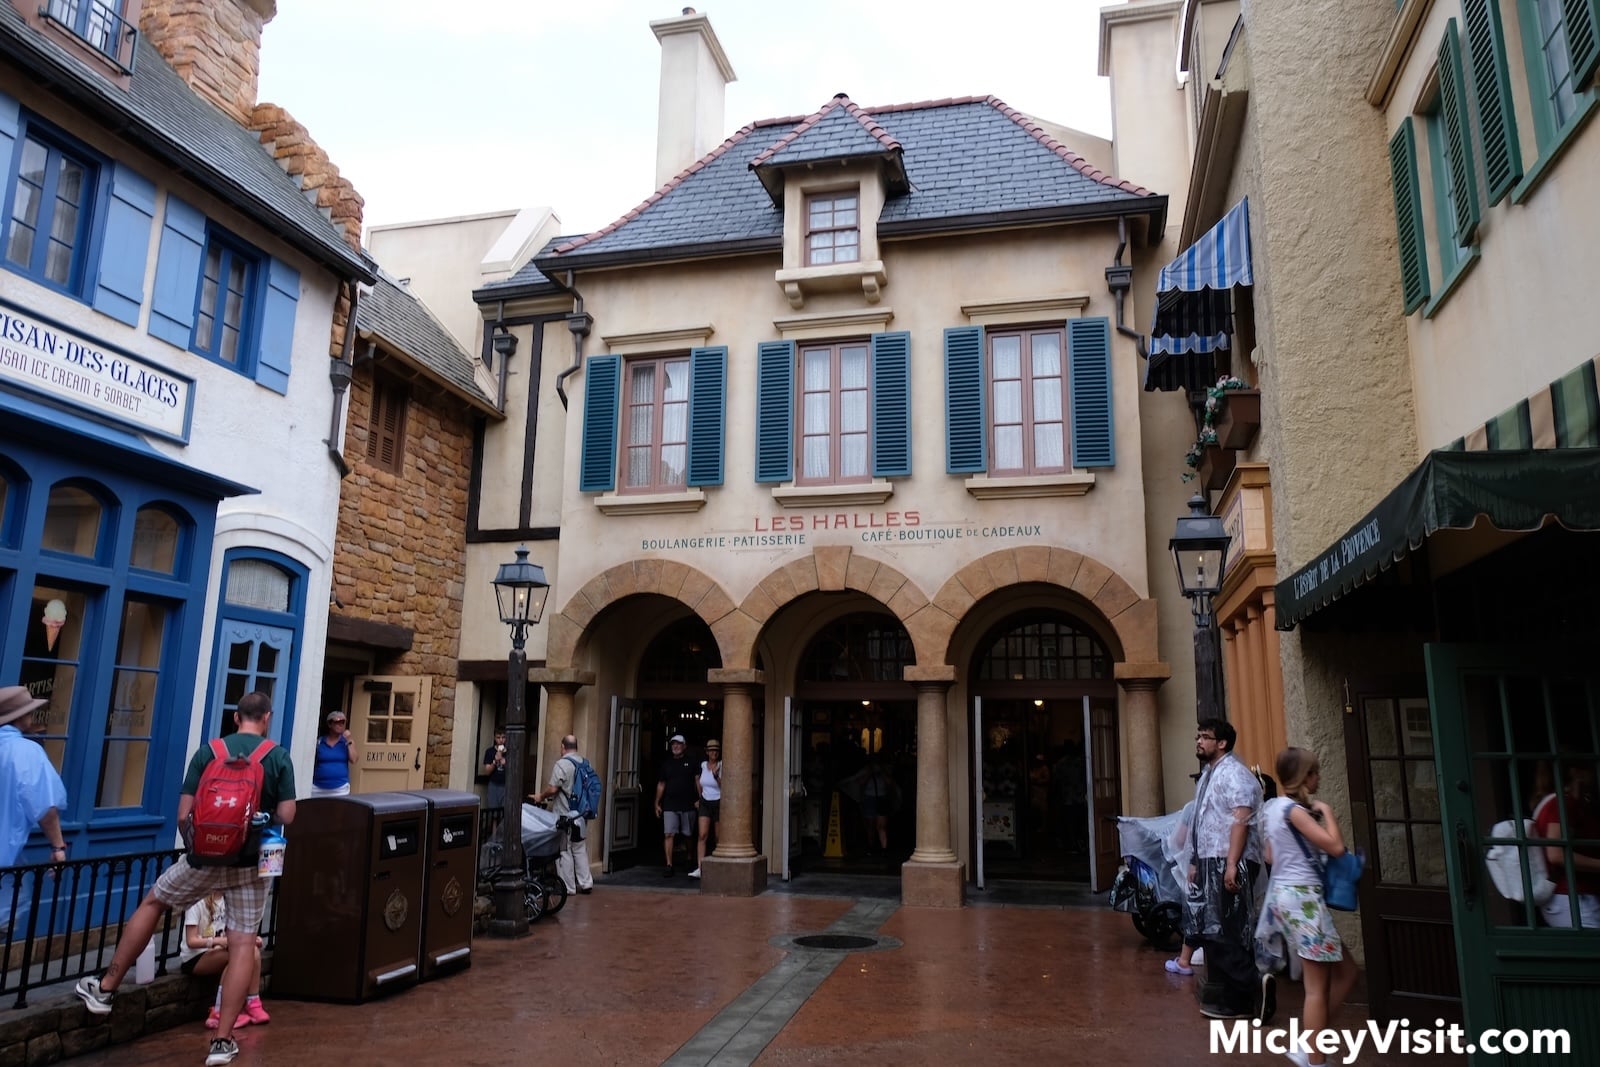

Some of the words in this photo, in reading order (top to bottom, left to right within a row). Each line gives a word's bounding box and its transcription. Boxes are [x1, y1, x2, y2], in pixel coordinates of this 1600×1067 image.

[0, 313, 57, 355] ISAN
[64, 338, 104, 374] DES
[110, 358, 179, 409] GLACES
[31, 357, 50, 381] ICE
[51, 366, 91, 396] CREAM
[93, 382, 101, 399] &
[104, 387, 142, 413] SORBET
[642, 536, 726, 550] BOULANGERIE
[733, 534, 806, 547] PATISSERIE
[899, 528, 963, 541] BOUTIQUE
[982, 525, 1041, 538] CADEAUX
[755, 515, 804, 532] LES
[812, 511, 921, 530] HALLES
[1330, 550, 1341, 576] LA
[1341, 517, 1381, 567] PROVENCE
[366, 751, 385, 762] EXIT
[387, 752, 407, 762] ONLY
